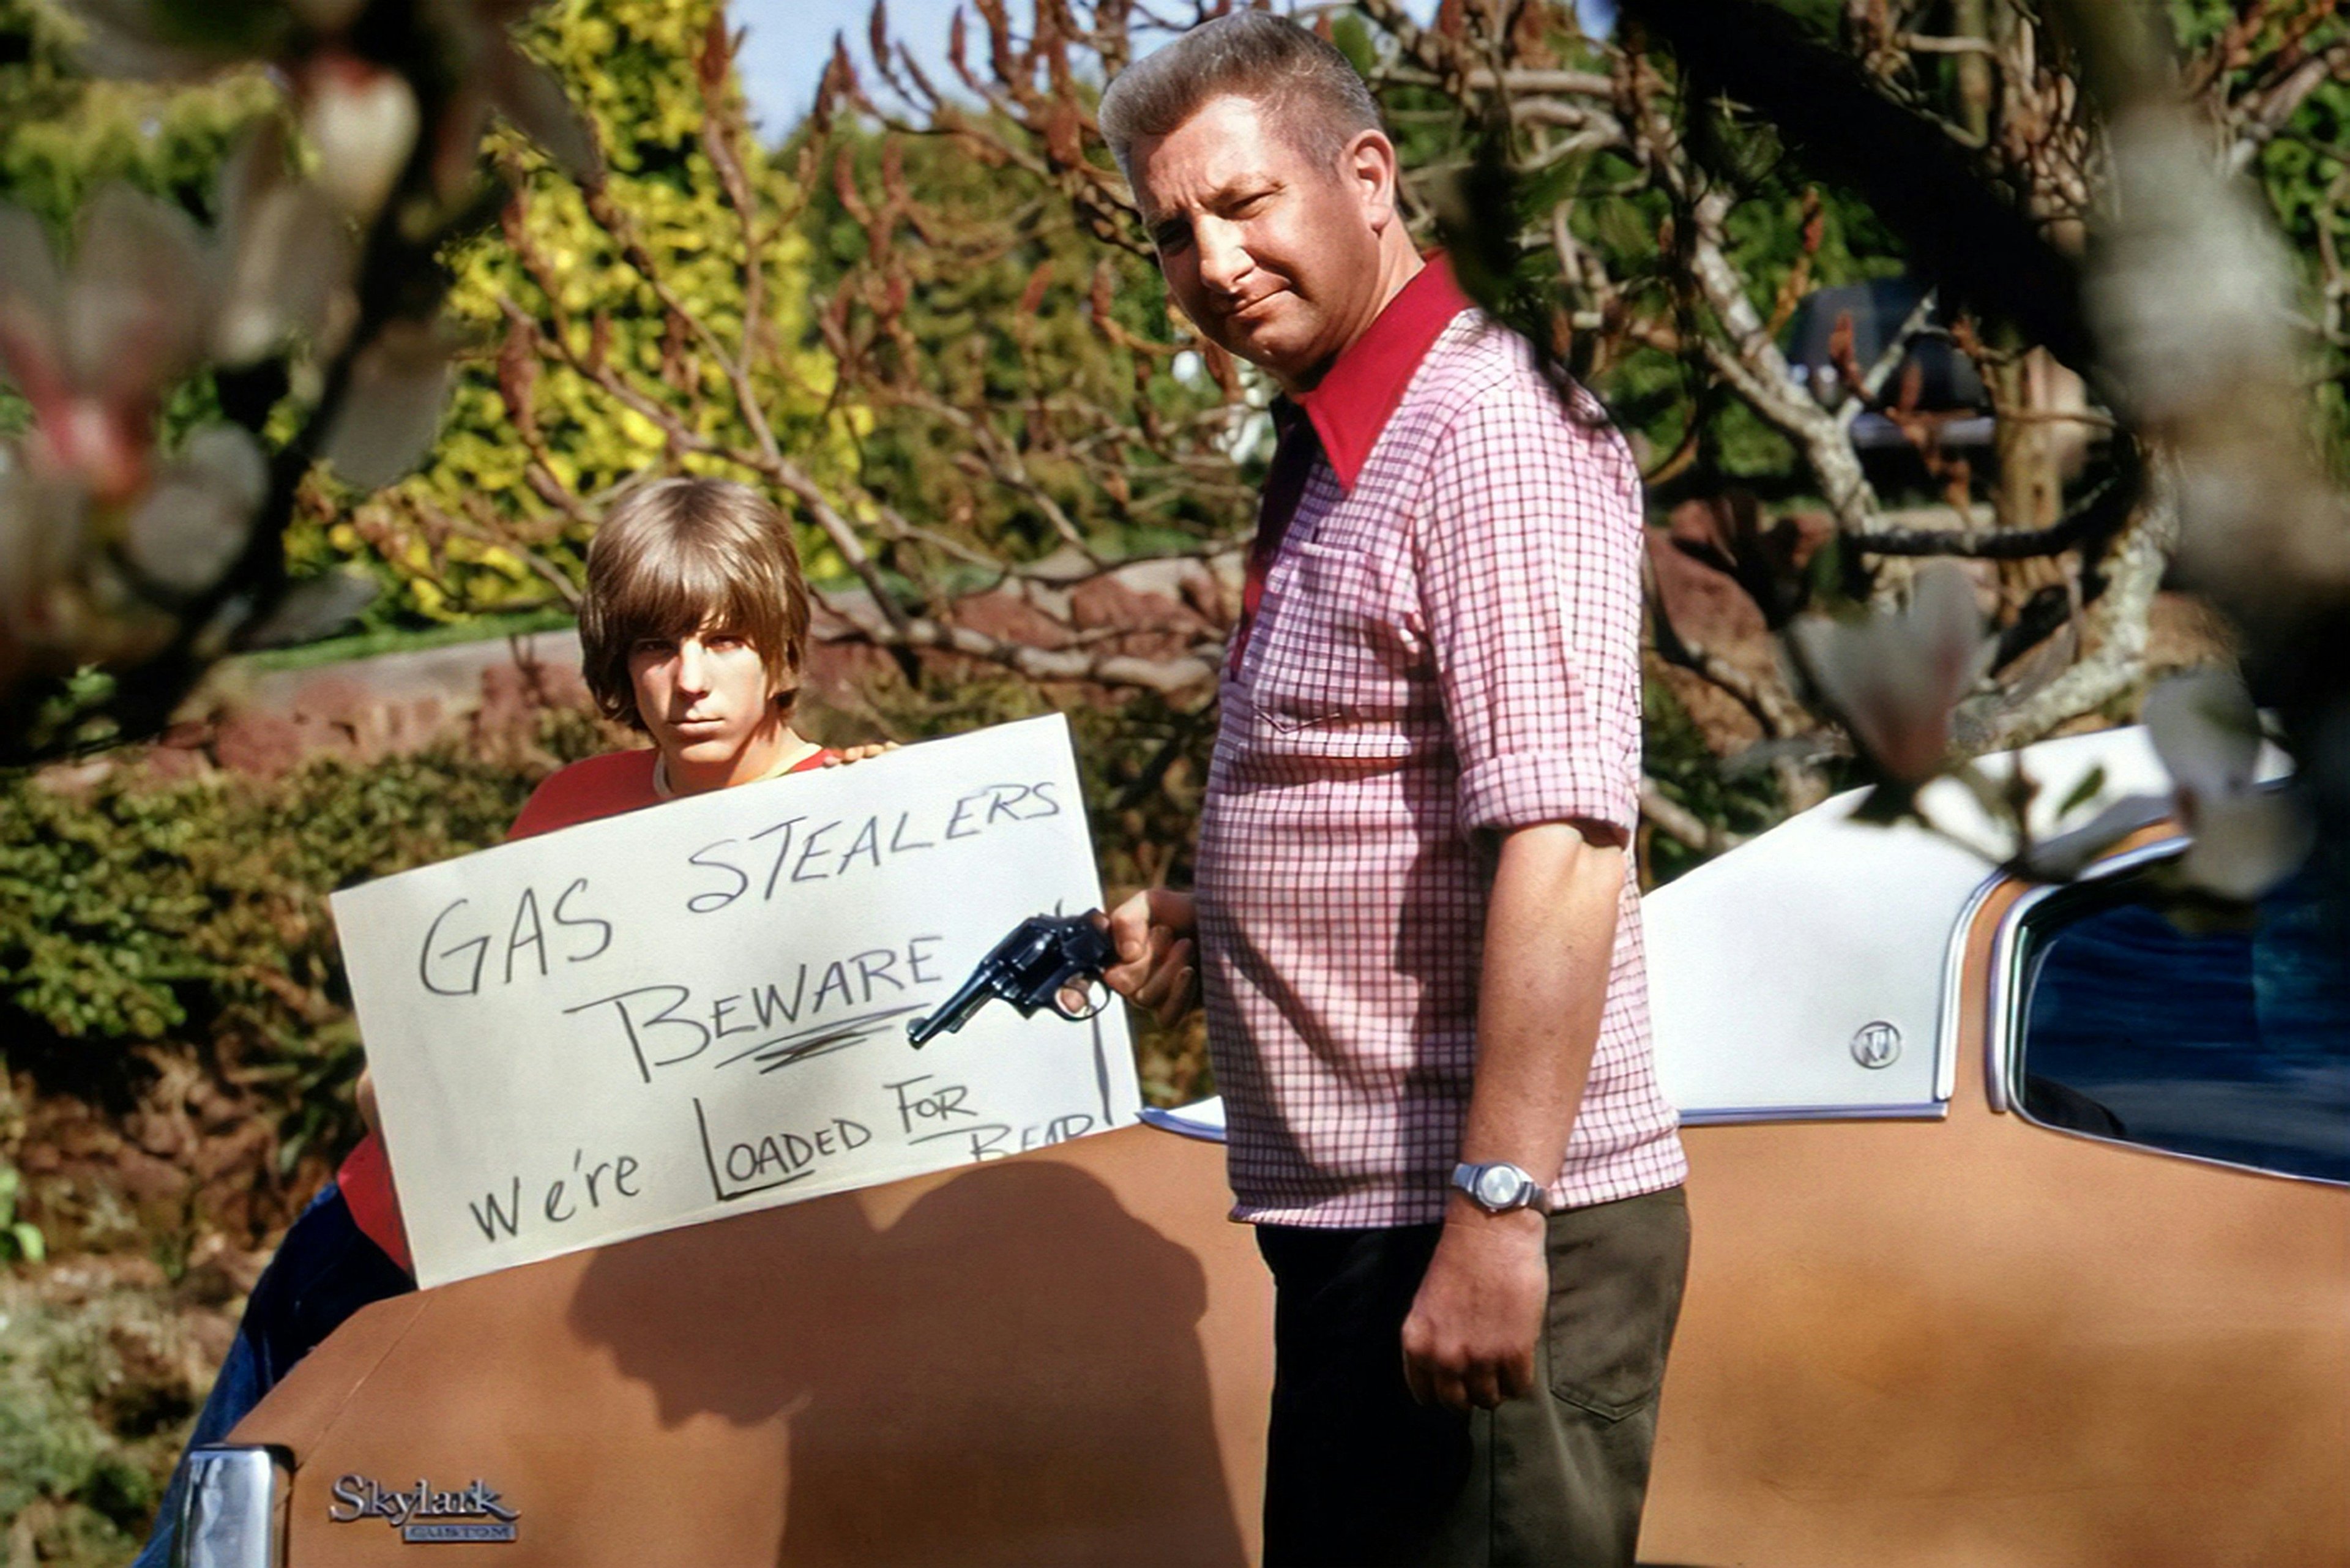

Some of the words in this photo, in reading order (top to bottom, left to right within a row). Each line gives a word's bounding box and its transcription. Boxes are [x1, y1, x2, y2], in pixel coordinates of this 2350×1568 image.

[419, 878, 612, 996] GAS
[686, 782, 1061, 914] STEALERS
[562, 936, 944, 1083] BEWARE
[469, 1148, 640, 1242] We're
[693, 1097, 872, 1201] LOADED
[882, 1074, 978, 1135] FOR
[328, 1473, 522, 1528] Skylark
[408, 1525, 512, 1539] CUSTOM
